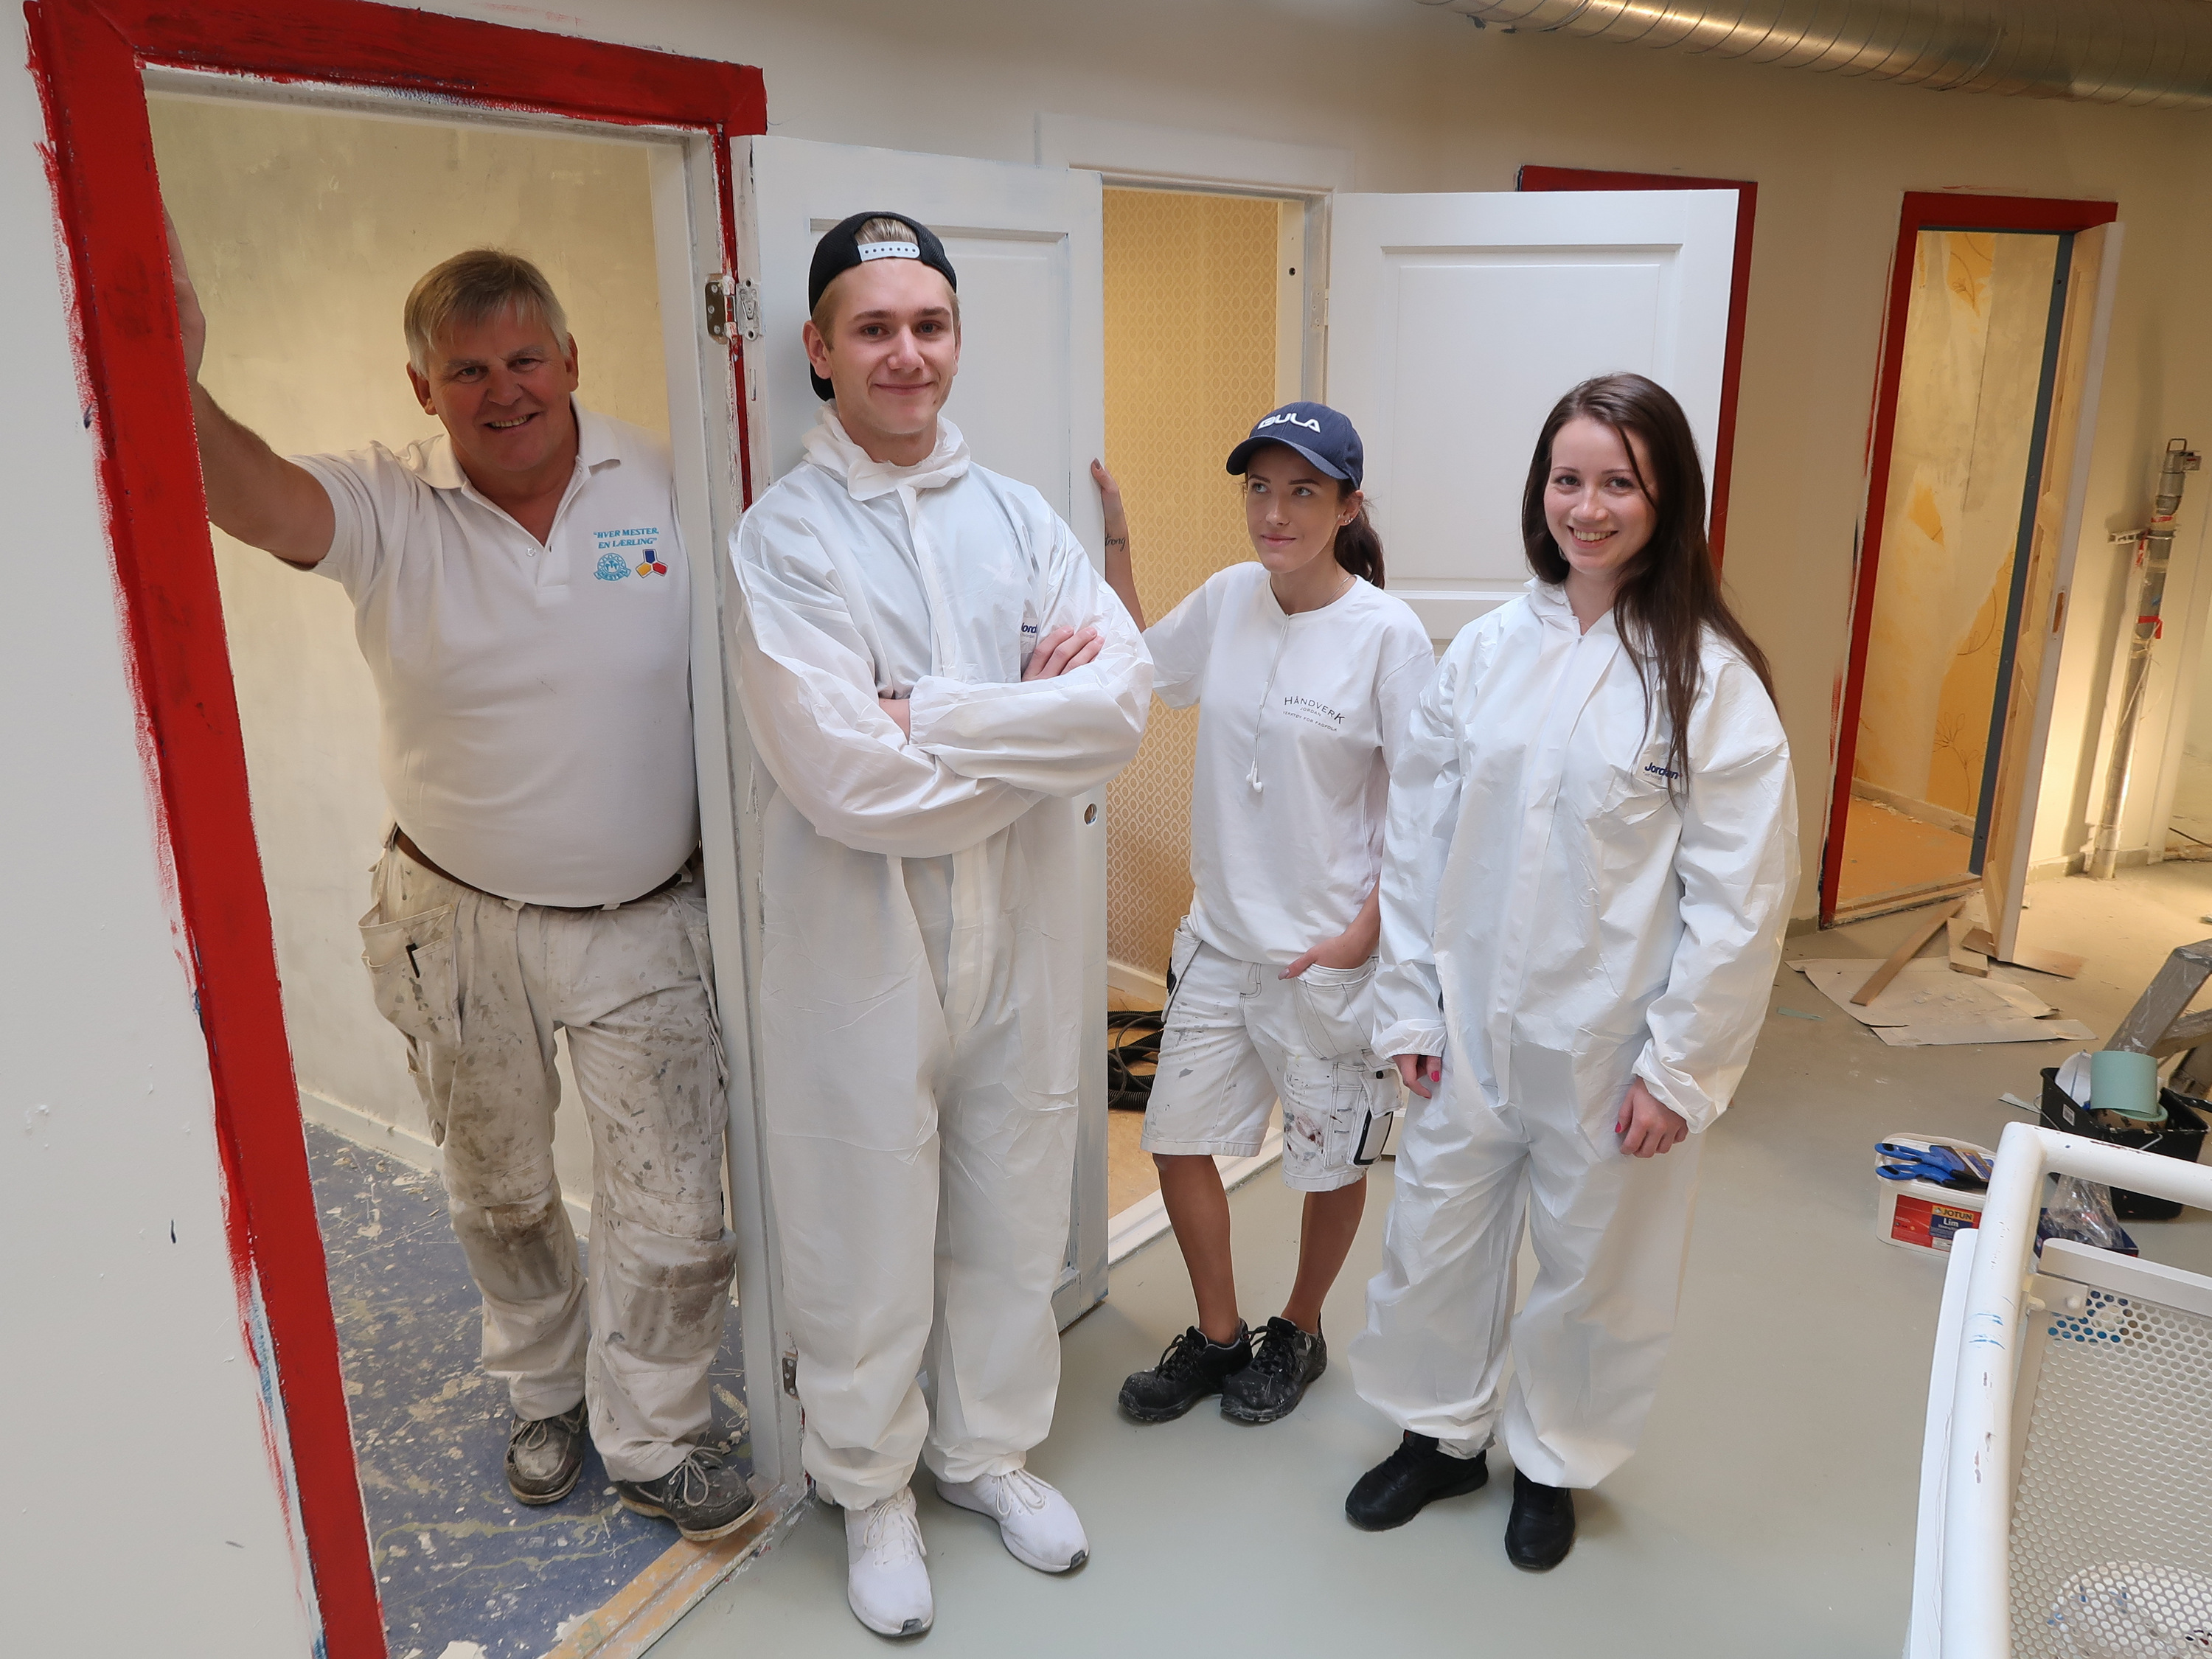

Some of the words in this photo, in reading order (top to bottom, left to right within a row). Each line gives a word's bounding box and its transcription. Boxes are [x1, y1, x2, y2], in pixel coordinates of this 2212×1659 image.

[1257, 413, 1321, 433] BULA
[1284, 695, 1346, 725] HÅNDVERK
[1300, 707, 1321, 717] JORDAN
[1943, 1209, 1972, 1220] JOTUN
[1943, 1217, 1959, 1228] Lim
